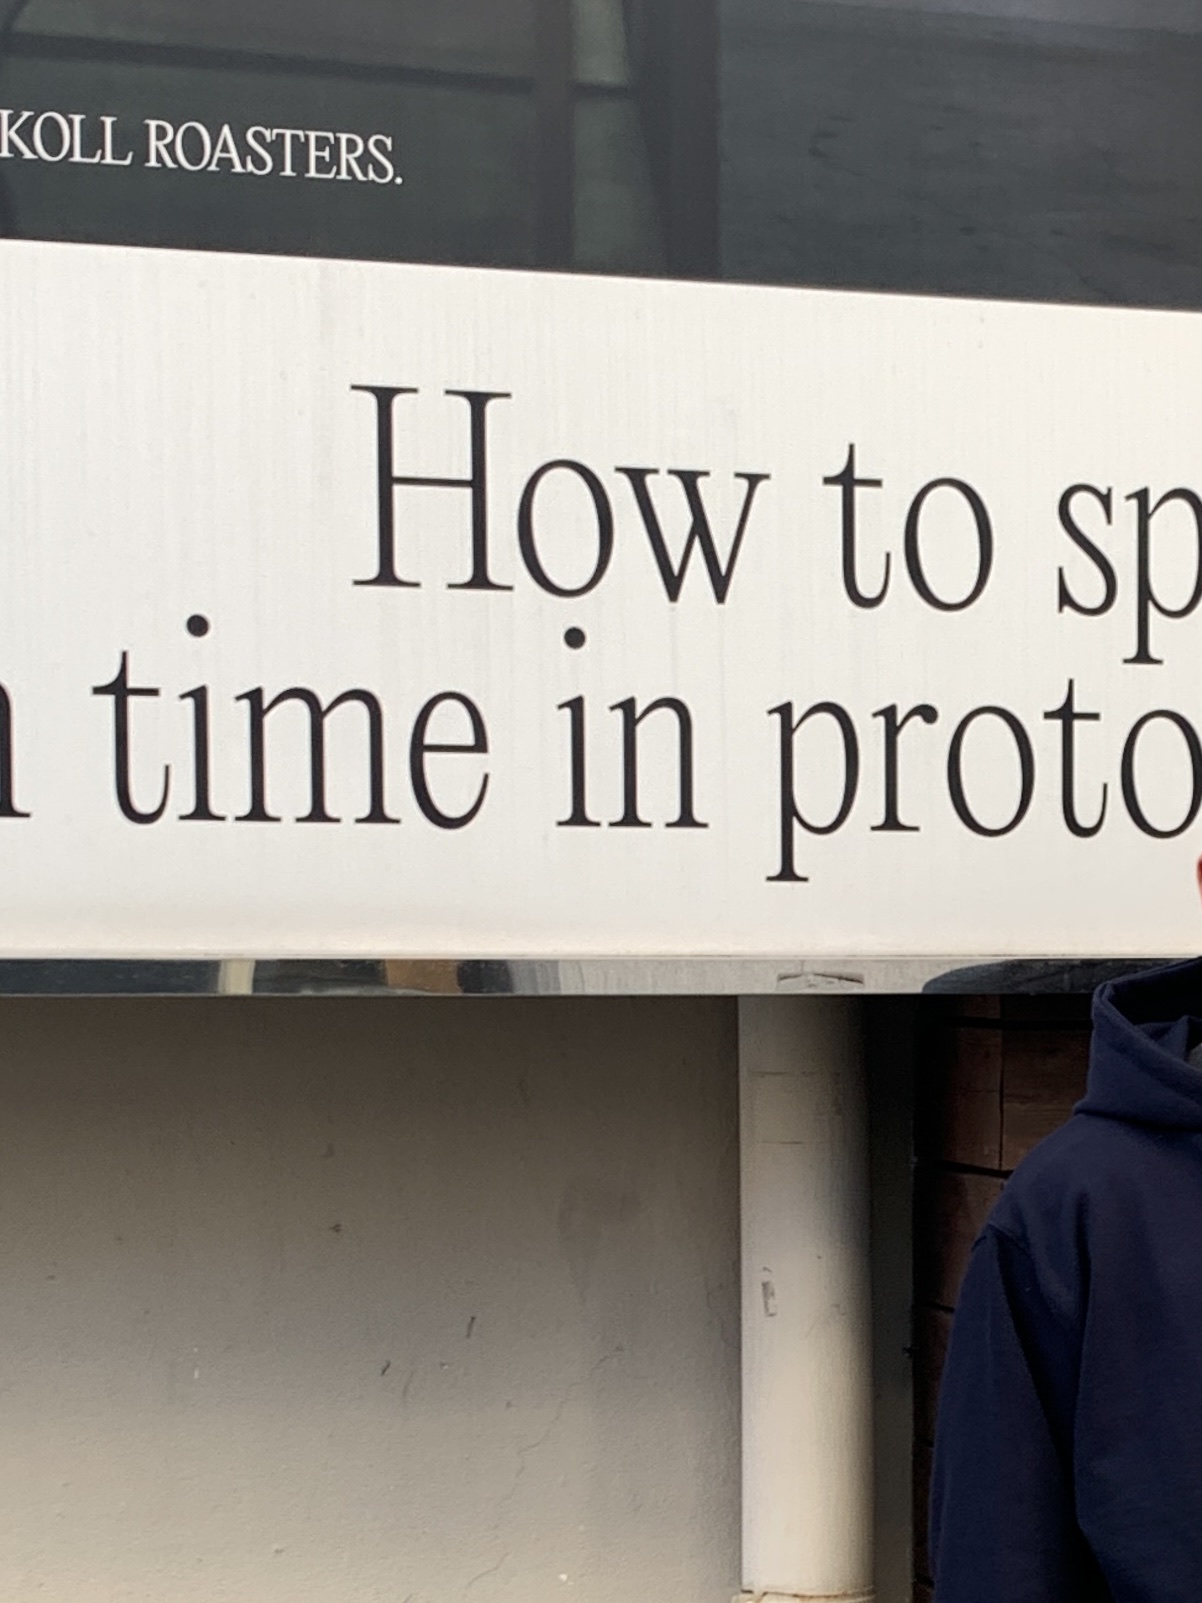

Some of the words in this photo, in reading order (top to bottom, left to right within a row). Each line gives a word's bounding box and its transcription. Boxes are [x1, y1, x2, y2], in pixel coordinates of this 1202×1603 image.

[0, 109, 133, 166] KOLL
[144, 119, 403, 185] ROASTERS.
[350, 384, 770, 604] How
[822, 443, 993, 612] to
[92, 614, 489, 830] time
[556, 626, 709, 829] in
